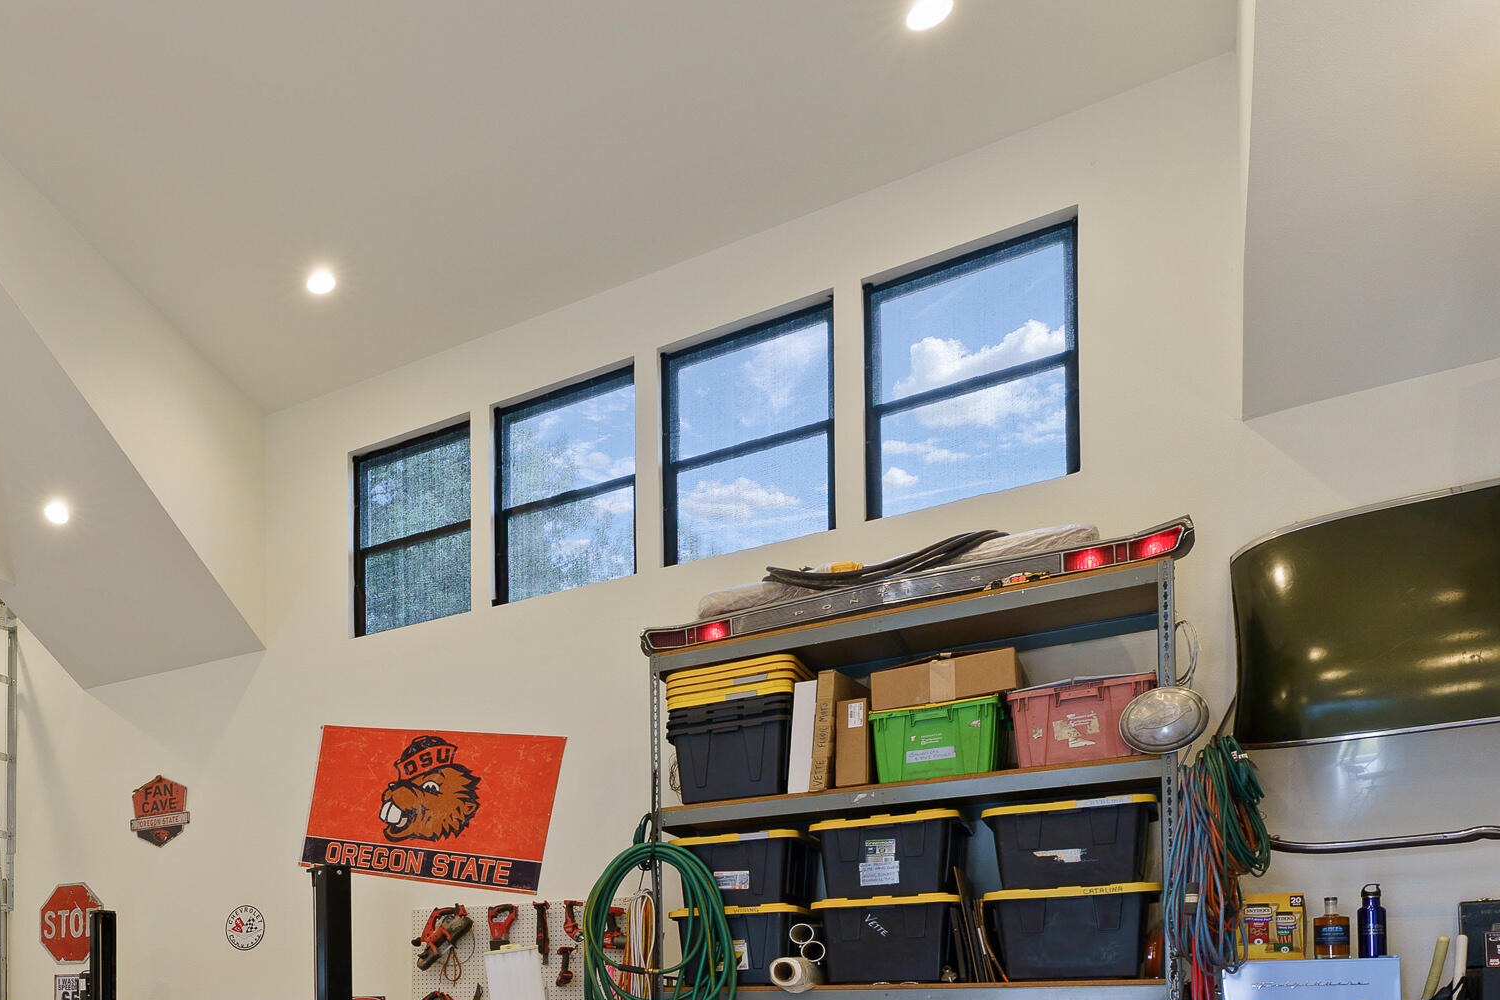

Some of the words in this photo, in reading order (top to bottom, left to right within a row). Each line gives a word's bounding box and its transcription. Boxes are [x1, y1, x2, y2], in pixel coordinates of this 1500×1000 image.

[817, 726, 828, 748] FLOOR
[404, 748, 451, 776] OSU
[813, 760, 825, 786] VETTE
[144, 783, 173, 801] FAN
[141, 797, 178, 814] CAVE
[140, 818, 161, 828] OREGON
[162, 815, 179, 825] STATE
[325, 841, 424, 875] OREGON
[431, 853, 512, 886] STATE
[1082, 886, 1123, 895] CATALINA
[1290, 896, 1302, 904] 20
[228, 907, 263, 925] CHEVROLET
[865, 913, 889, 937] VETTE
